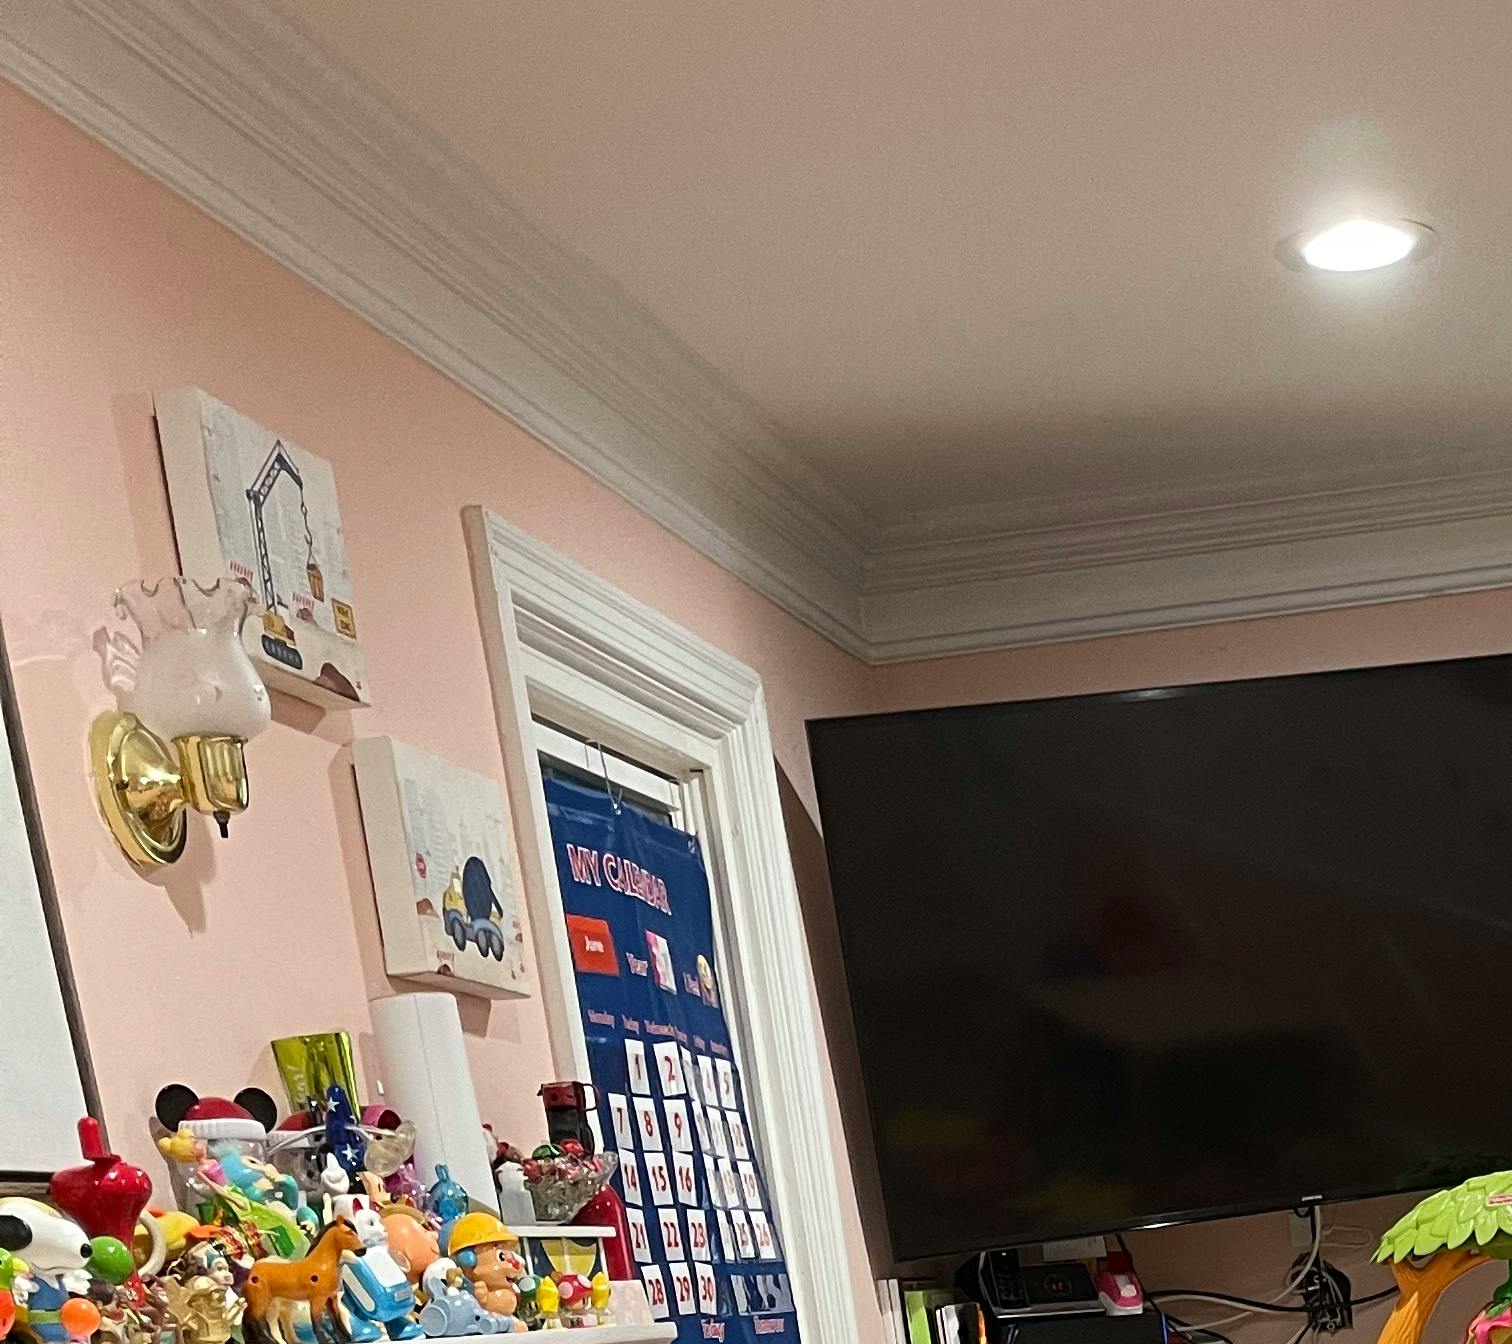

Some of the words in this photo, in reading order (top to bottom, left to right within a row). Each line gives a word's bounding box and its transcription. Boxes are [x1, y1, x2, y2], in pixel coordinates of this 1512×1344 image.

[566, 843, 601, 886] MY
[634, 1054, 642, 1080] 1
[664, 1056, 675, 1082] 2
[616, 1107, 623, 1133] 7
[644, 1110, 653, 1137] 8
[674, 1112, 682, 1138] 9
[624, 1163, 637, 1191] 14
[652, 1165, 666, 1191] 15
[678, 1167, 693, 1192] 16
[632, 1222, 647, 1249] 21
[663, 1221, 680, 1248] 22
[690, 1222, 706, 1248] 23
[756, 1223, 771, 1247] 26
[648, 1279, 664, 1305] 28
[676, 1278, 691, 1302] 29
[700, 1276, 713, 1302] 30
